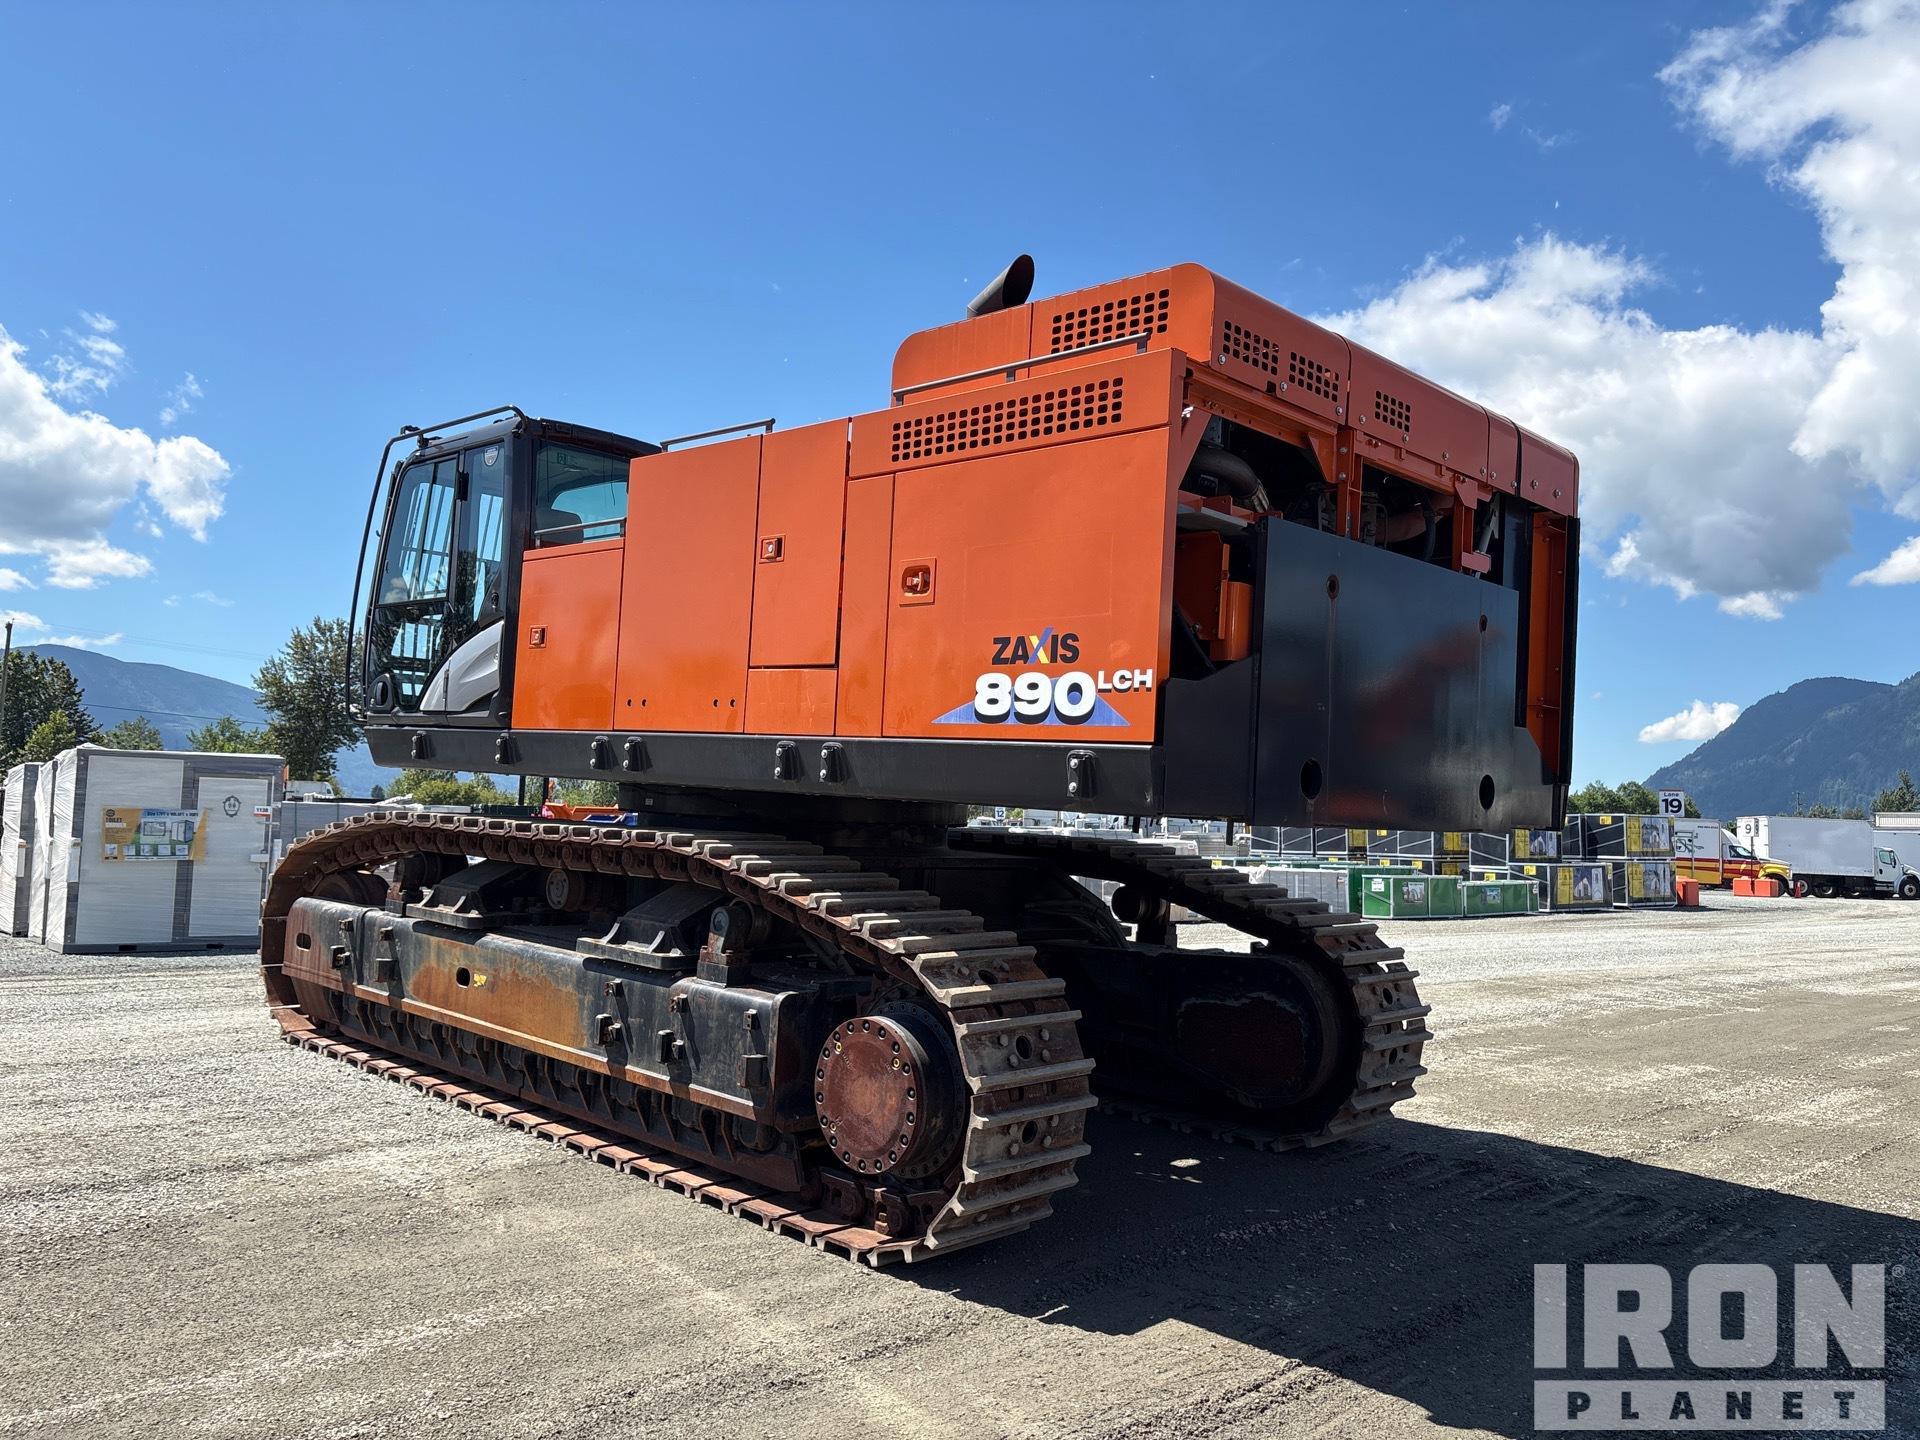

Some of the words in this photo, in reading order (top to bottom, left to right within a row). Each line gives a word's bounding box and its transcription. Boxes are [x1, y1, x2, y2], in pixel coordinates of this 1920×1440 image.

[991, 627, 1080, 665] ZAXIS
[973, 671, 1097, 725] 890
[1097, 668, 1153, 694] LCH
[996, 810, 1005, 818] 12
[1661, 798, 1682, 814] 19
[1745, 824, 1752, 834] 9
